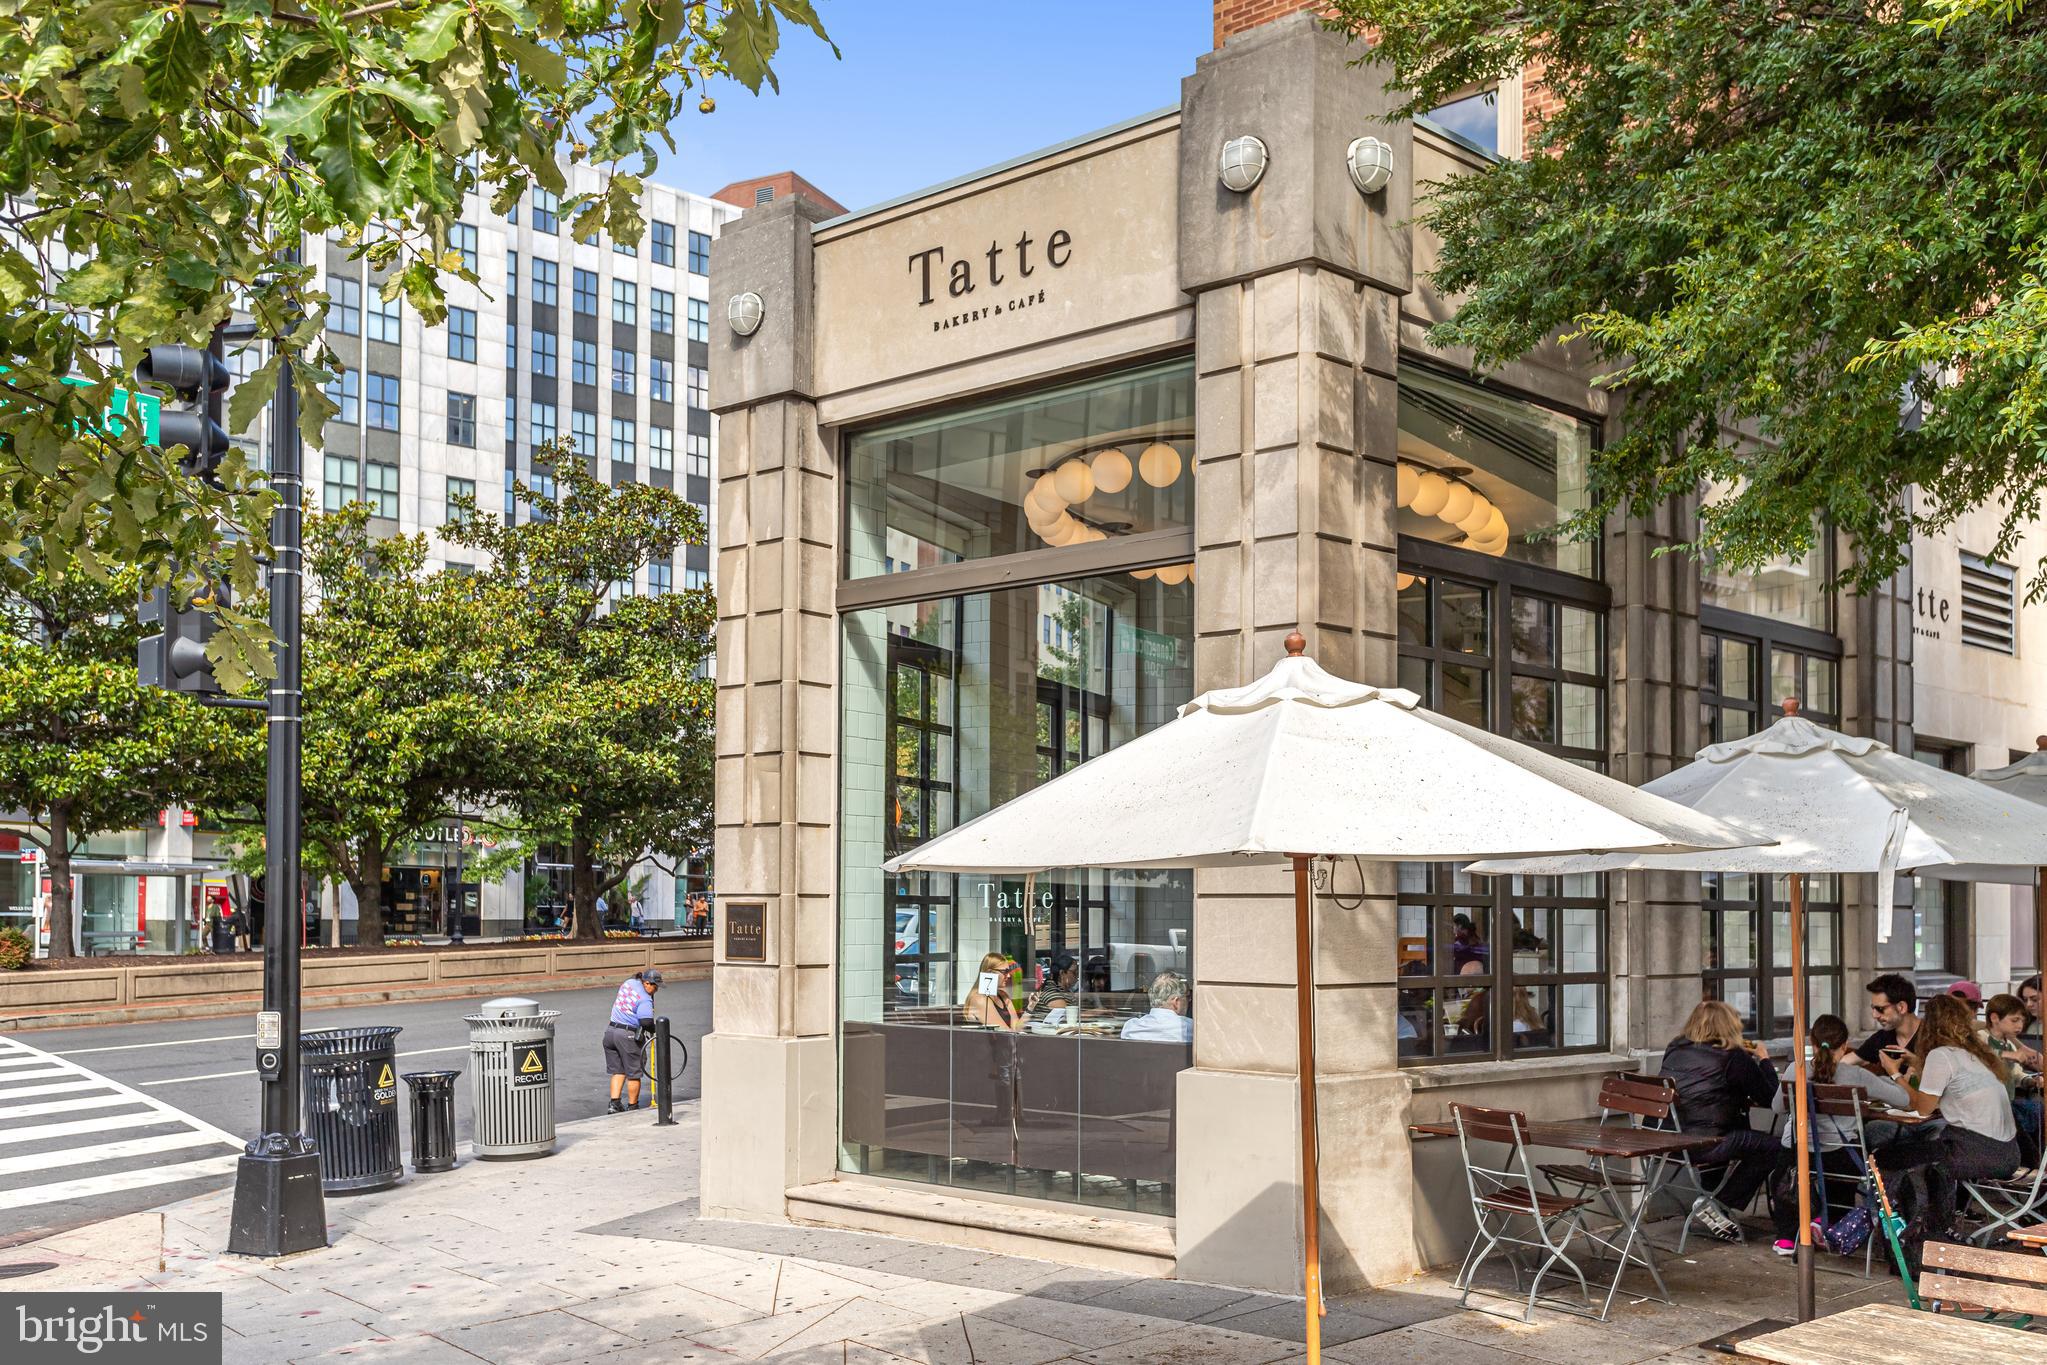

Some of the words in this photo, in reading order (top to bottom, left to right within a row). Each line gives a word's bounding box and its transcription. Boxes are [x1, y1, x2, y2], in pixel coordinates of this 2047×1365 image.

[908, 229, 1072, 307] Tatte
[933, 307, 989, 332] BAKERY
[994, 304, 1002, 316] &
[1008, 289, 1045, 311] CAFÉ
[1917, 586, 1949, 623] tte
[728, 921, 761, 935] Tatte
[984, 977, 993, 991] 7
[515, 1072, 548, 1084] RECYCLE
